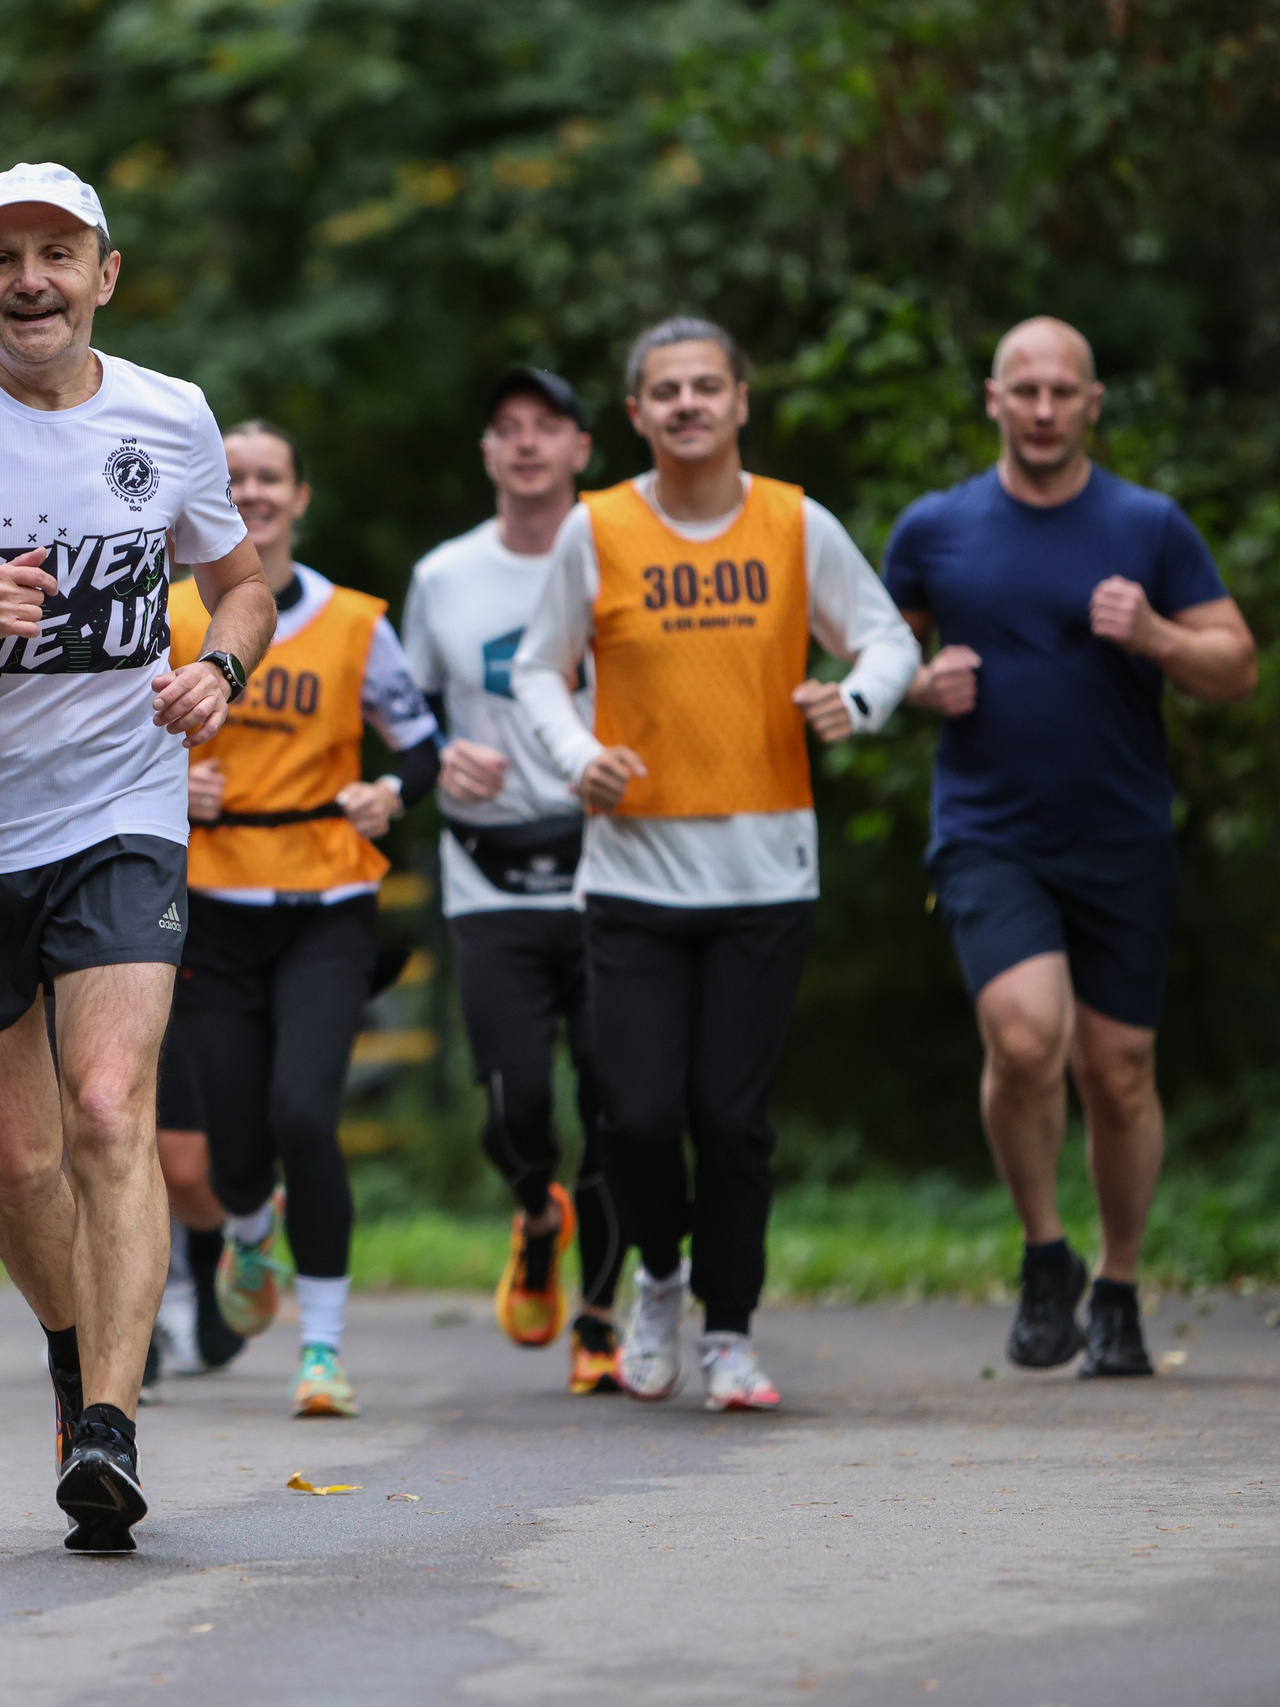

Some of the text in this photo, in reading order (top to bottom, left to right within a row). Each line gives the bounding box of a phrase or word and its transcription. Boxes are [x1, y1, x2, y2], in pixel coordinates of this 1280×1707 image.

[107, 446, 154, 466] GOLDEN RING
[110, 486, 157, 504] ULTRA TRAIL
[643, 559, 768, 611] 30:00
